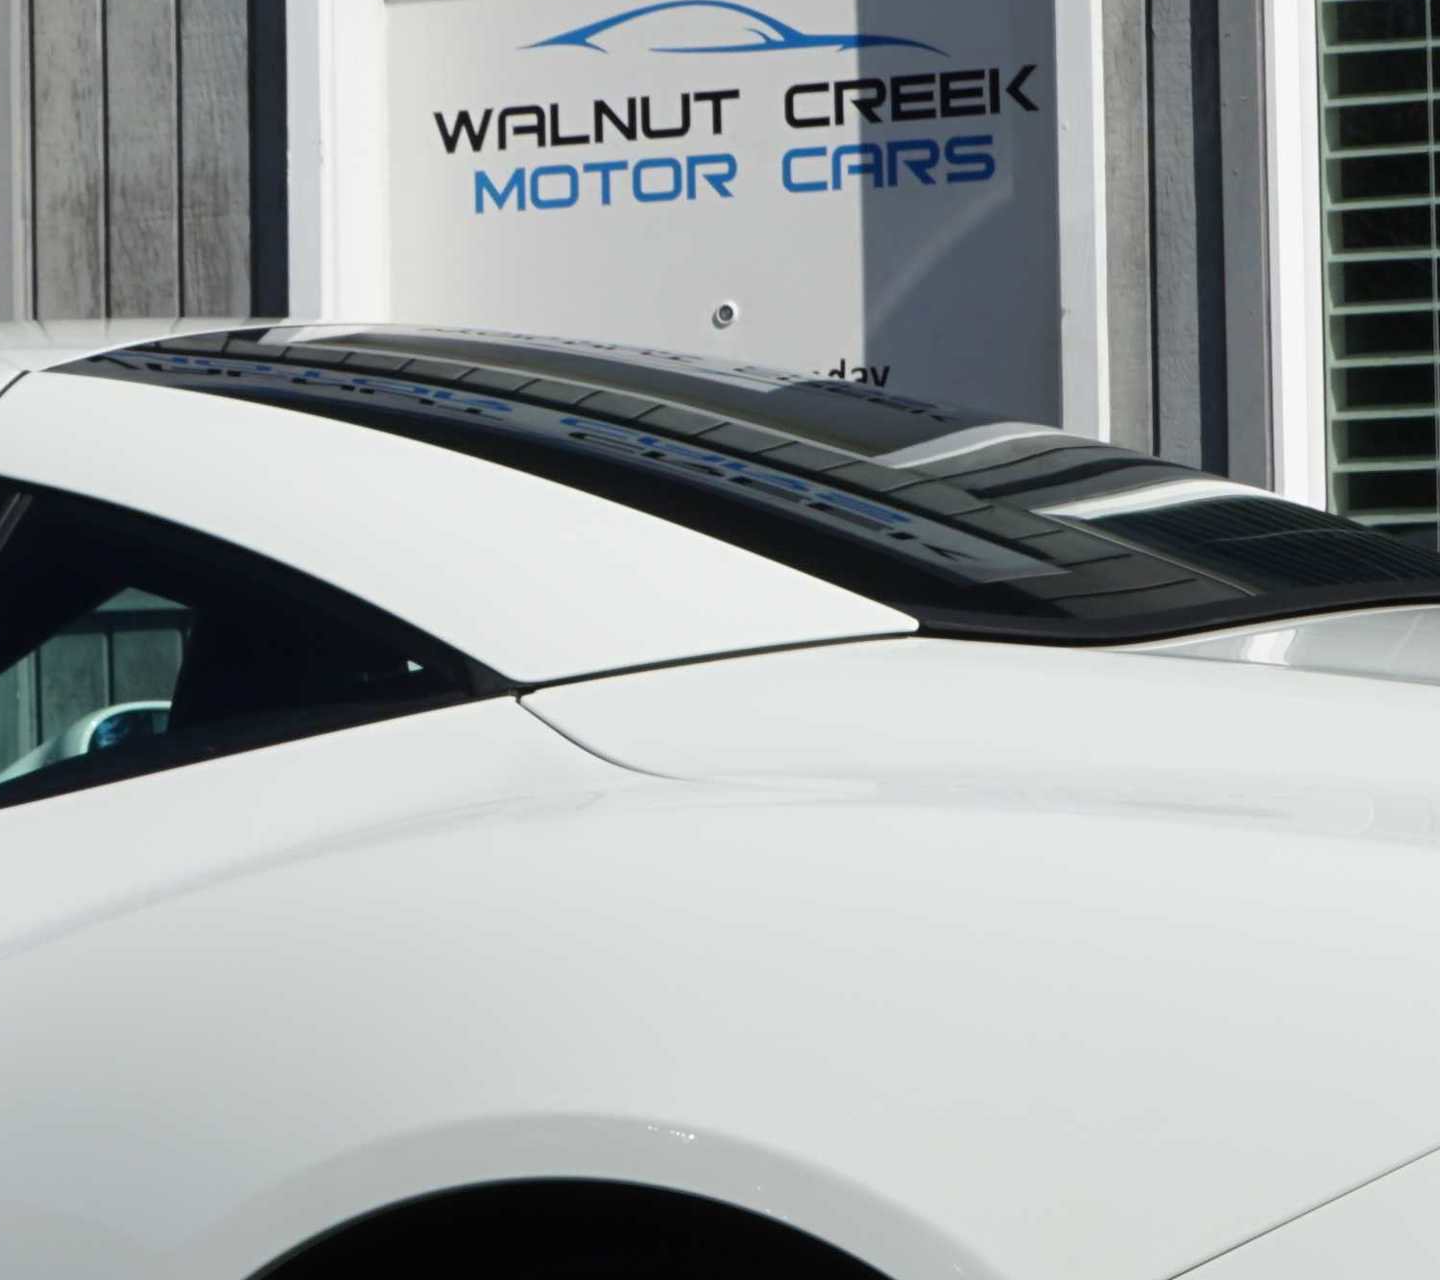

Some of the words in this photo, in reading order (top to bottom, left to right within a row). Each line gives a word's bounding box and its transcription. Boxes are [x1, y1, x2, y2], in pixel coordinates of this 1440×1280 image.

[433, 89, 740, 154] WALNUT
[784, 64, 1040, 129] CREEK
[474, 152, 737, 214] MOTOR
[781, 134, 996, 193] CARS
